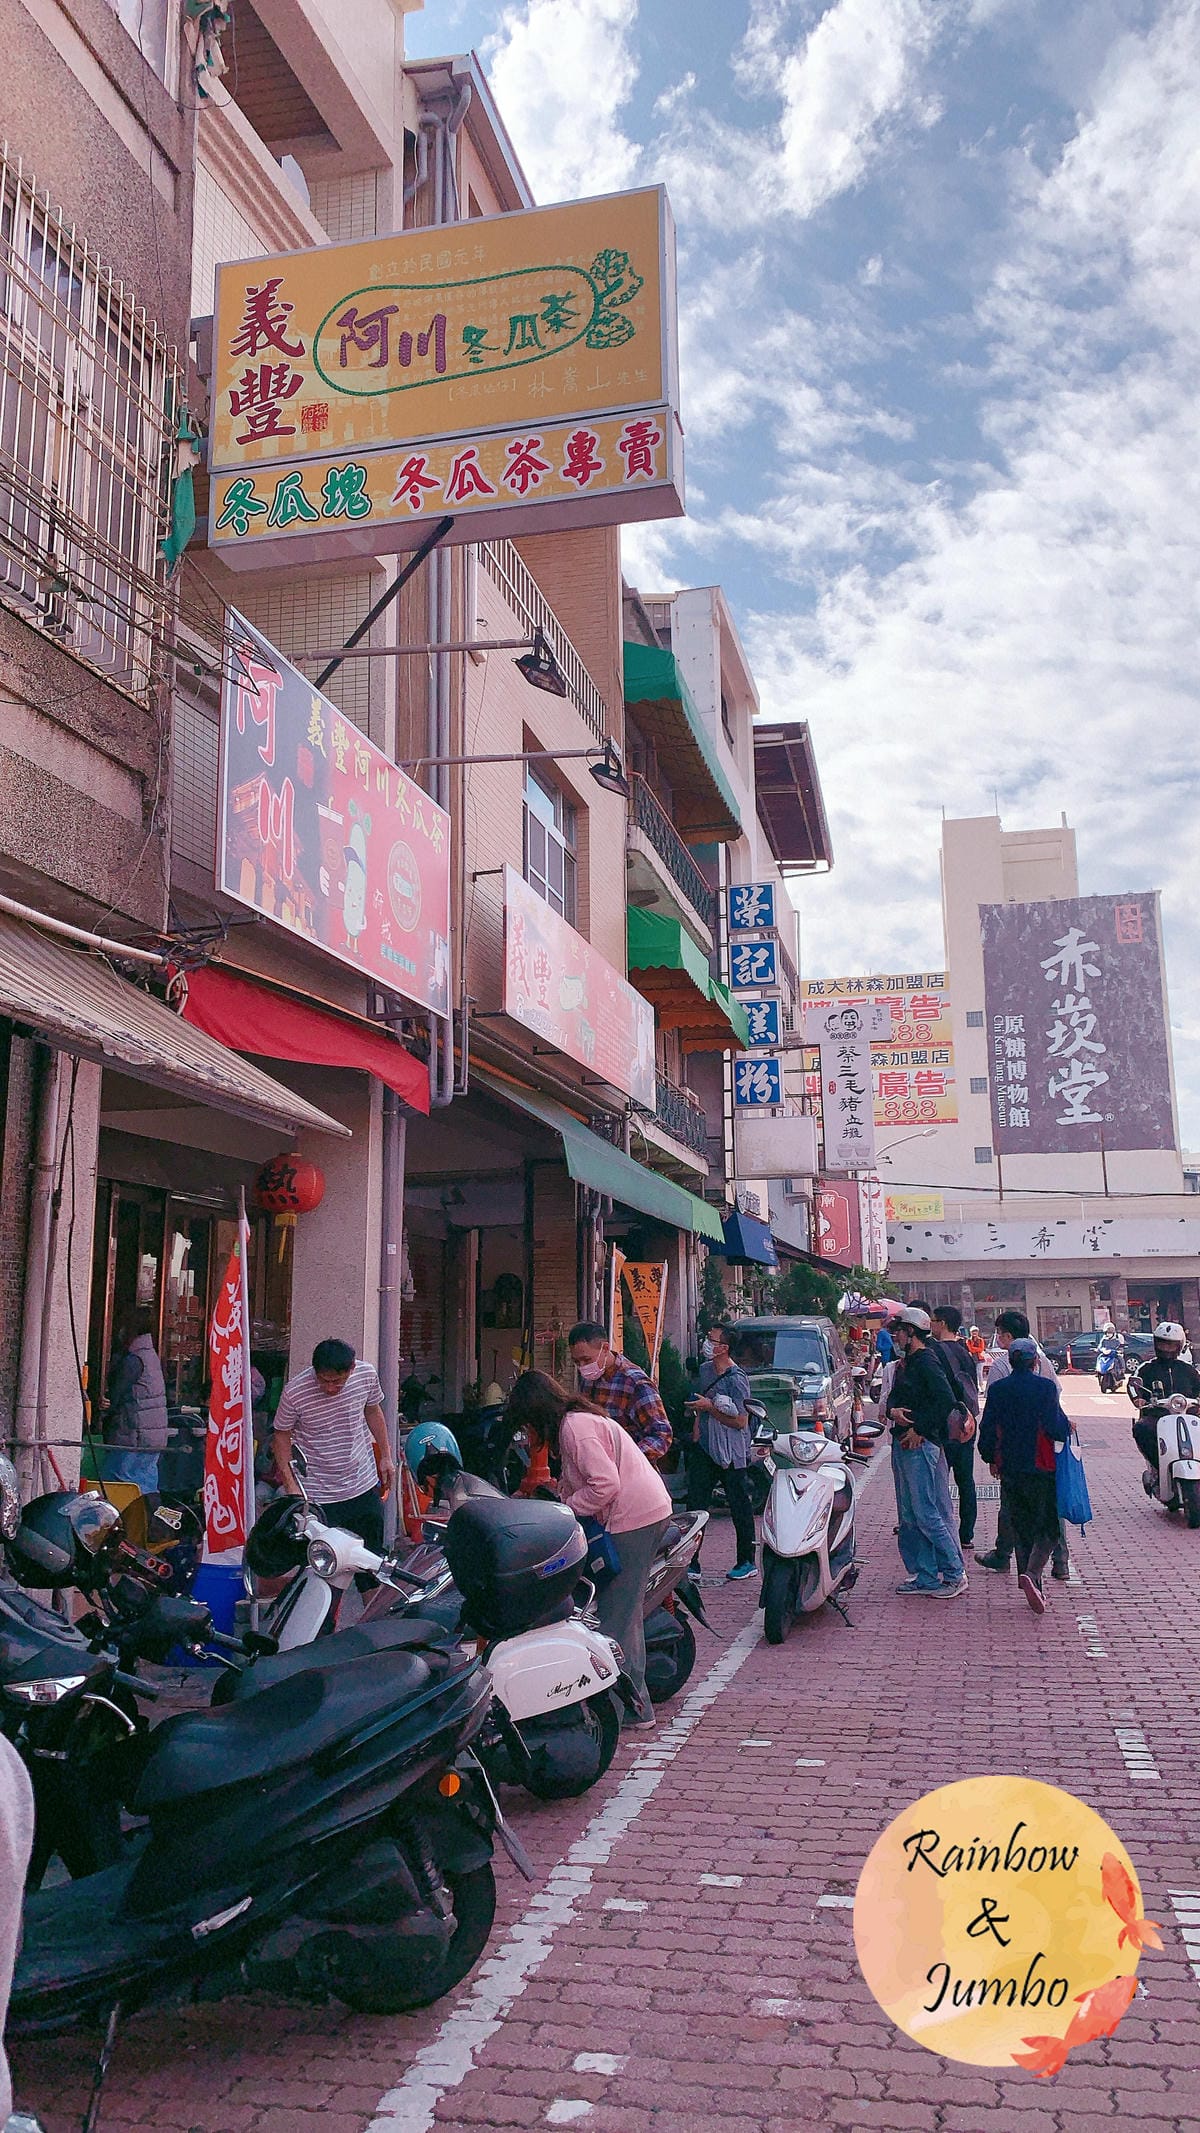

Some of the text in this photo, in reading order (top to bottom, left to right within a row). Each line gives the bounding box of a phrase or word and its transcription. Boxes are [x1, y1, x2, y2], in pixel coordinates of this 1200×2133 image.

[228, 277, 305, 446] 義豐
[216, 417, 665, 535] 冬瓜塊 冬瓜茶專賣
[807, 974, 945, 996] 成大林森加盟店
[1040, 926, 1110, 1127] 赤崁堂
[997, 1085, 1008, 1128] Museum
[1004, 1014, 1031, 1129] 原糖博物館
